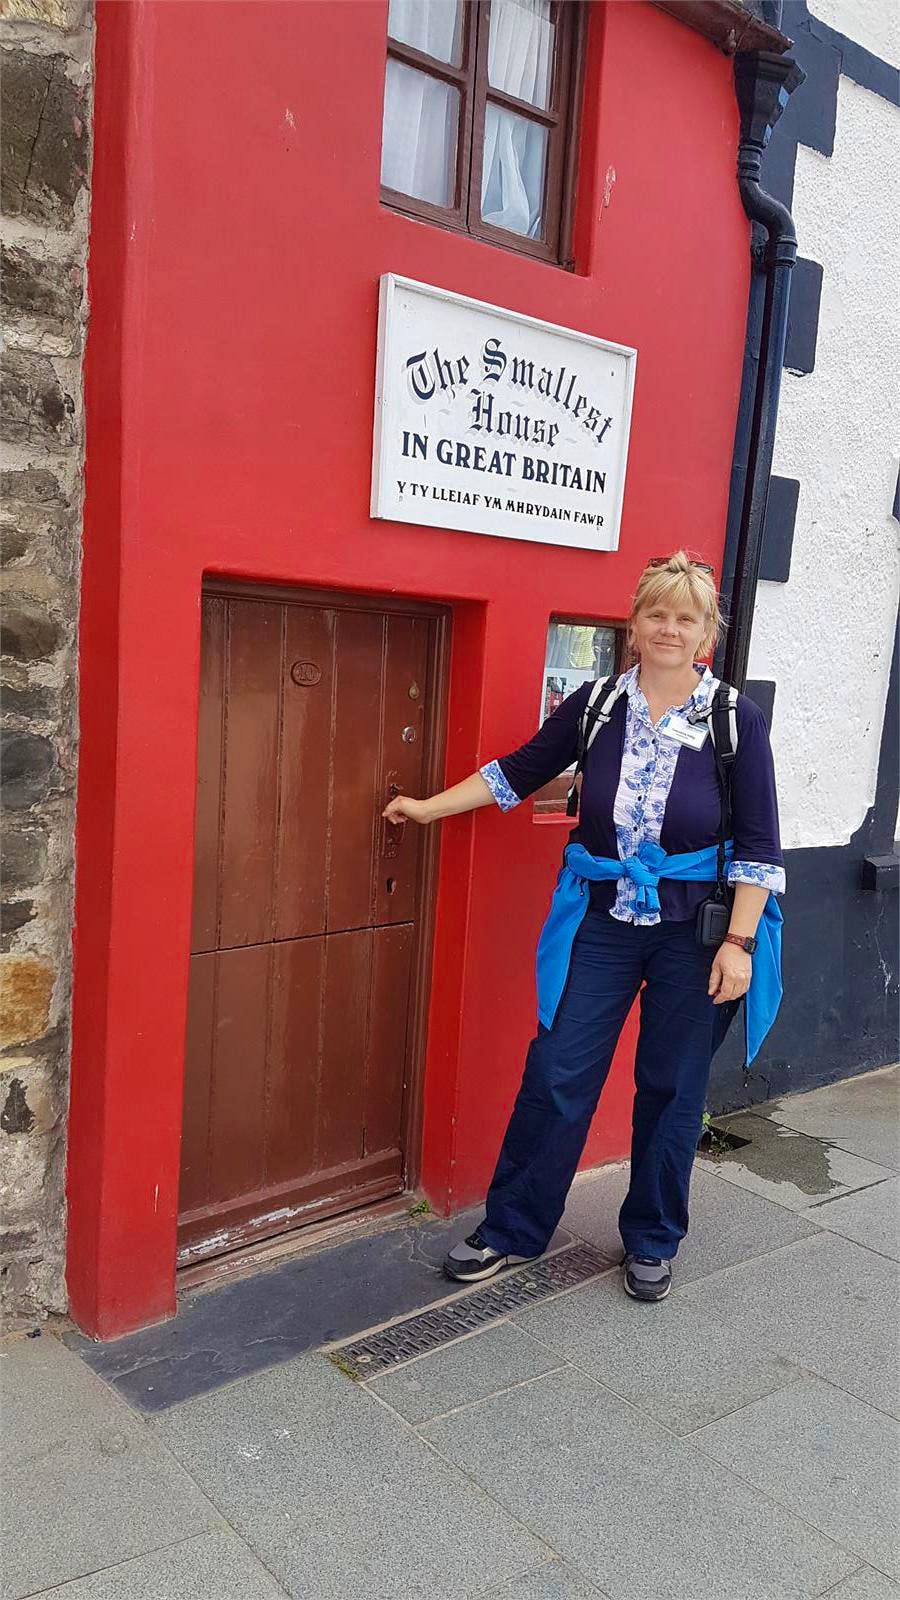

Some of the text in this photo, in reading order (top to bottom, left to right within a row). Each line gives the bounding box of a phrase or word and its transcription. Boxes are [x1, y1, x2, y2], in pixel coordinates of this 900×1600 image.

[406, 338, 613, 444] The Smallest
[469, 388, 560, 447] House
[401, 431, 607, 494] IN GREAT BRITAIN
[397, 481, 604, 527] Y TY LLEIAF YM MHRYDAIN FAWR
